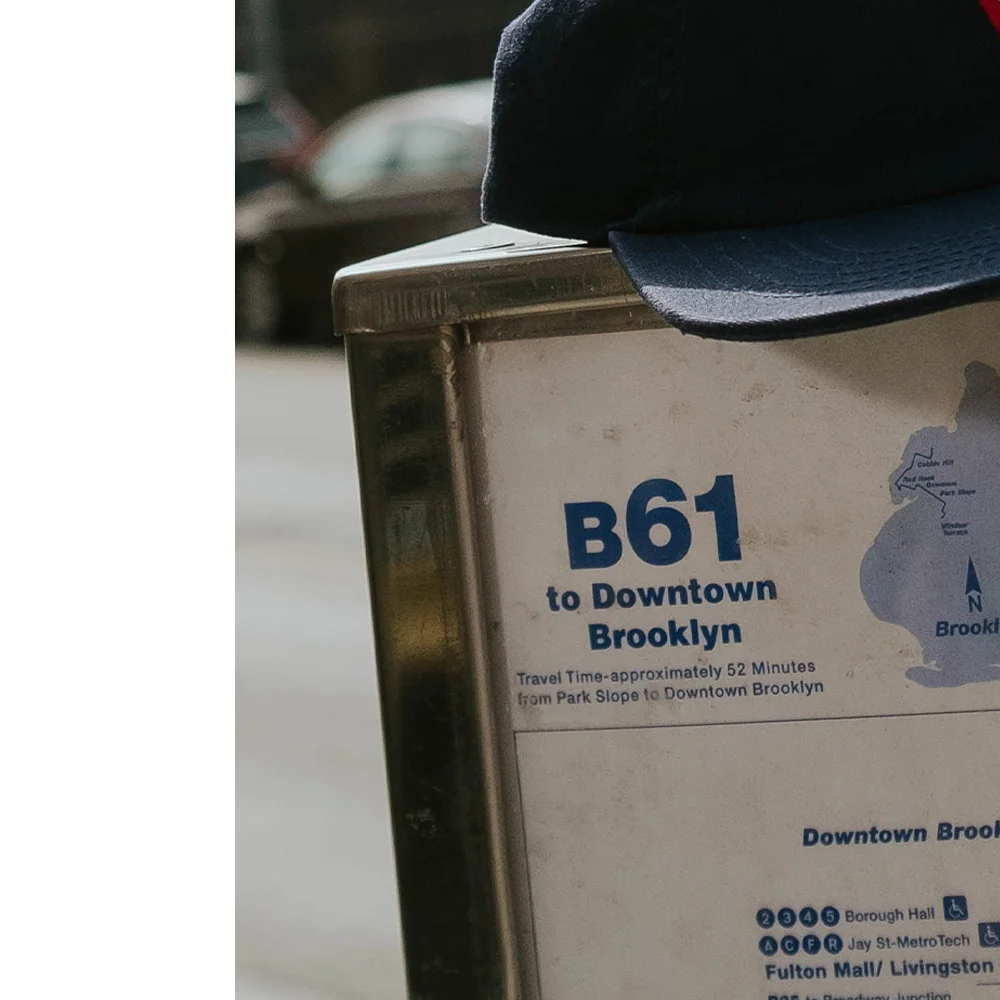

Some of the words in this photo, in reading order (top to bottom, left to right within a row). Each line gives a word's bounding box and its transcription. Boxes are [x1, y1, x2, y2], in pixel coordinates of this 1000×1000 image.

[564, 475, 742, 569] B61
[547, 587, 580, 611] to
[592, 579, 777, 609] Downtown
[968, 594, 983, 612] N
[588, 619, 741, 651] Brooklyn
[516, 671, 561, 685] Travel
[566, 665, 722, 684] Time-approximately
[728, 663, 746, 676] 52
[752, 661, 815, 675] Minutes
[517, 692, 551, 708] from
[557, 691, 591, 704] Park
[596, 690, 639, 704] Slope
[643, 688, 659, 701] to
[664, 686, 747, 699] Downtown
[753, 681, 823, 696] Brooklyn
[803, 827, 927, 846] Downtown
[845, 909, 903, 924] Borough
[909, 907, 934, 920] Hall
[848, 938, 871, 952] Jay
[877, 934, 970, 949] St-MetroTech
[766, 964, 826, 979] Fulton
[834, 961, 882, 977] Mall/
[890, 959, 993, 978] Livingston
